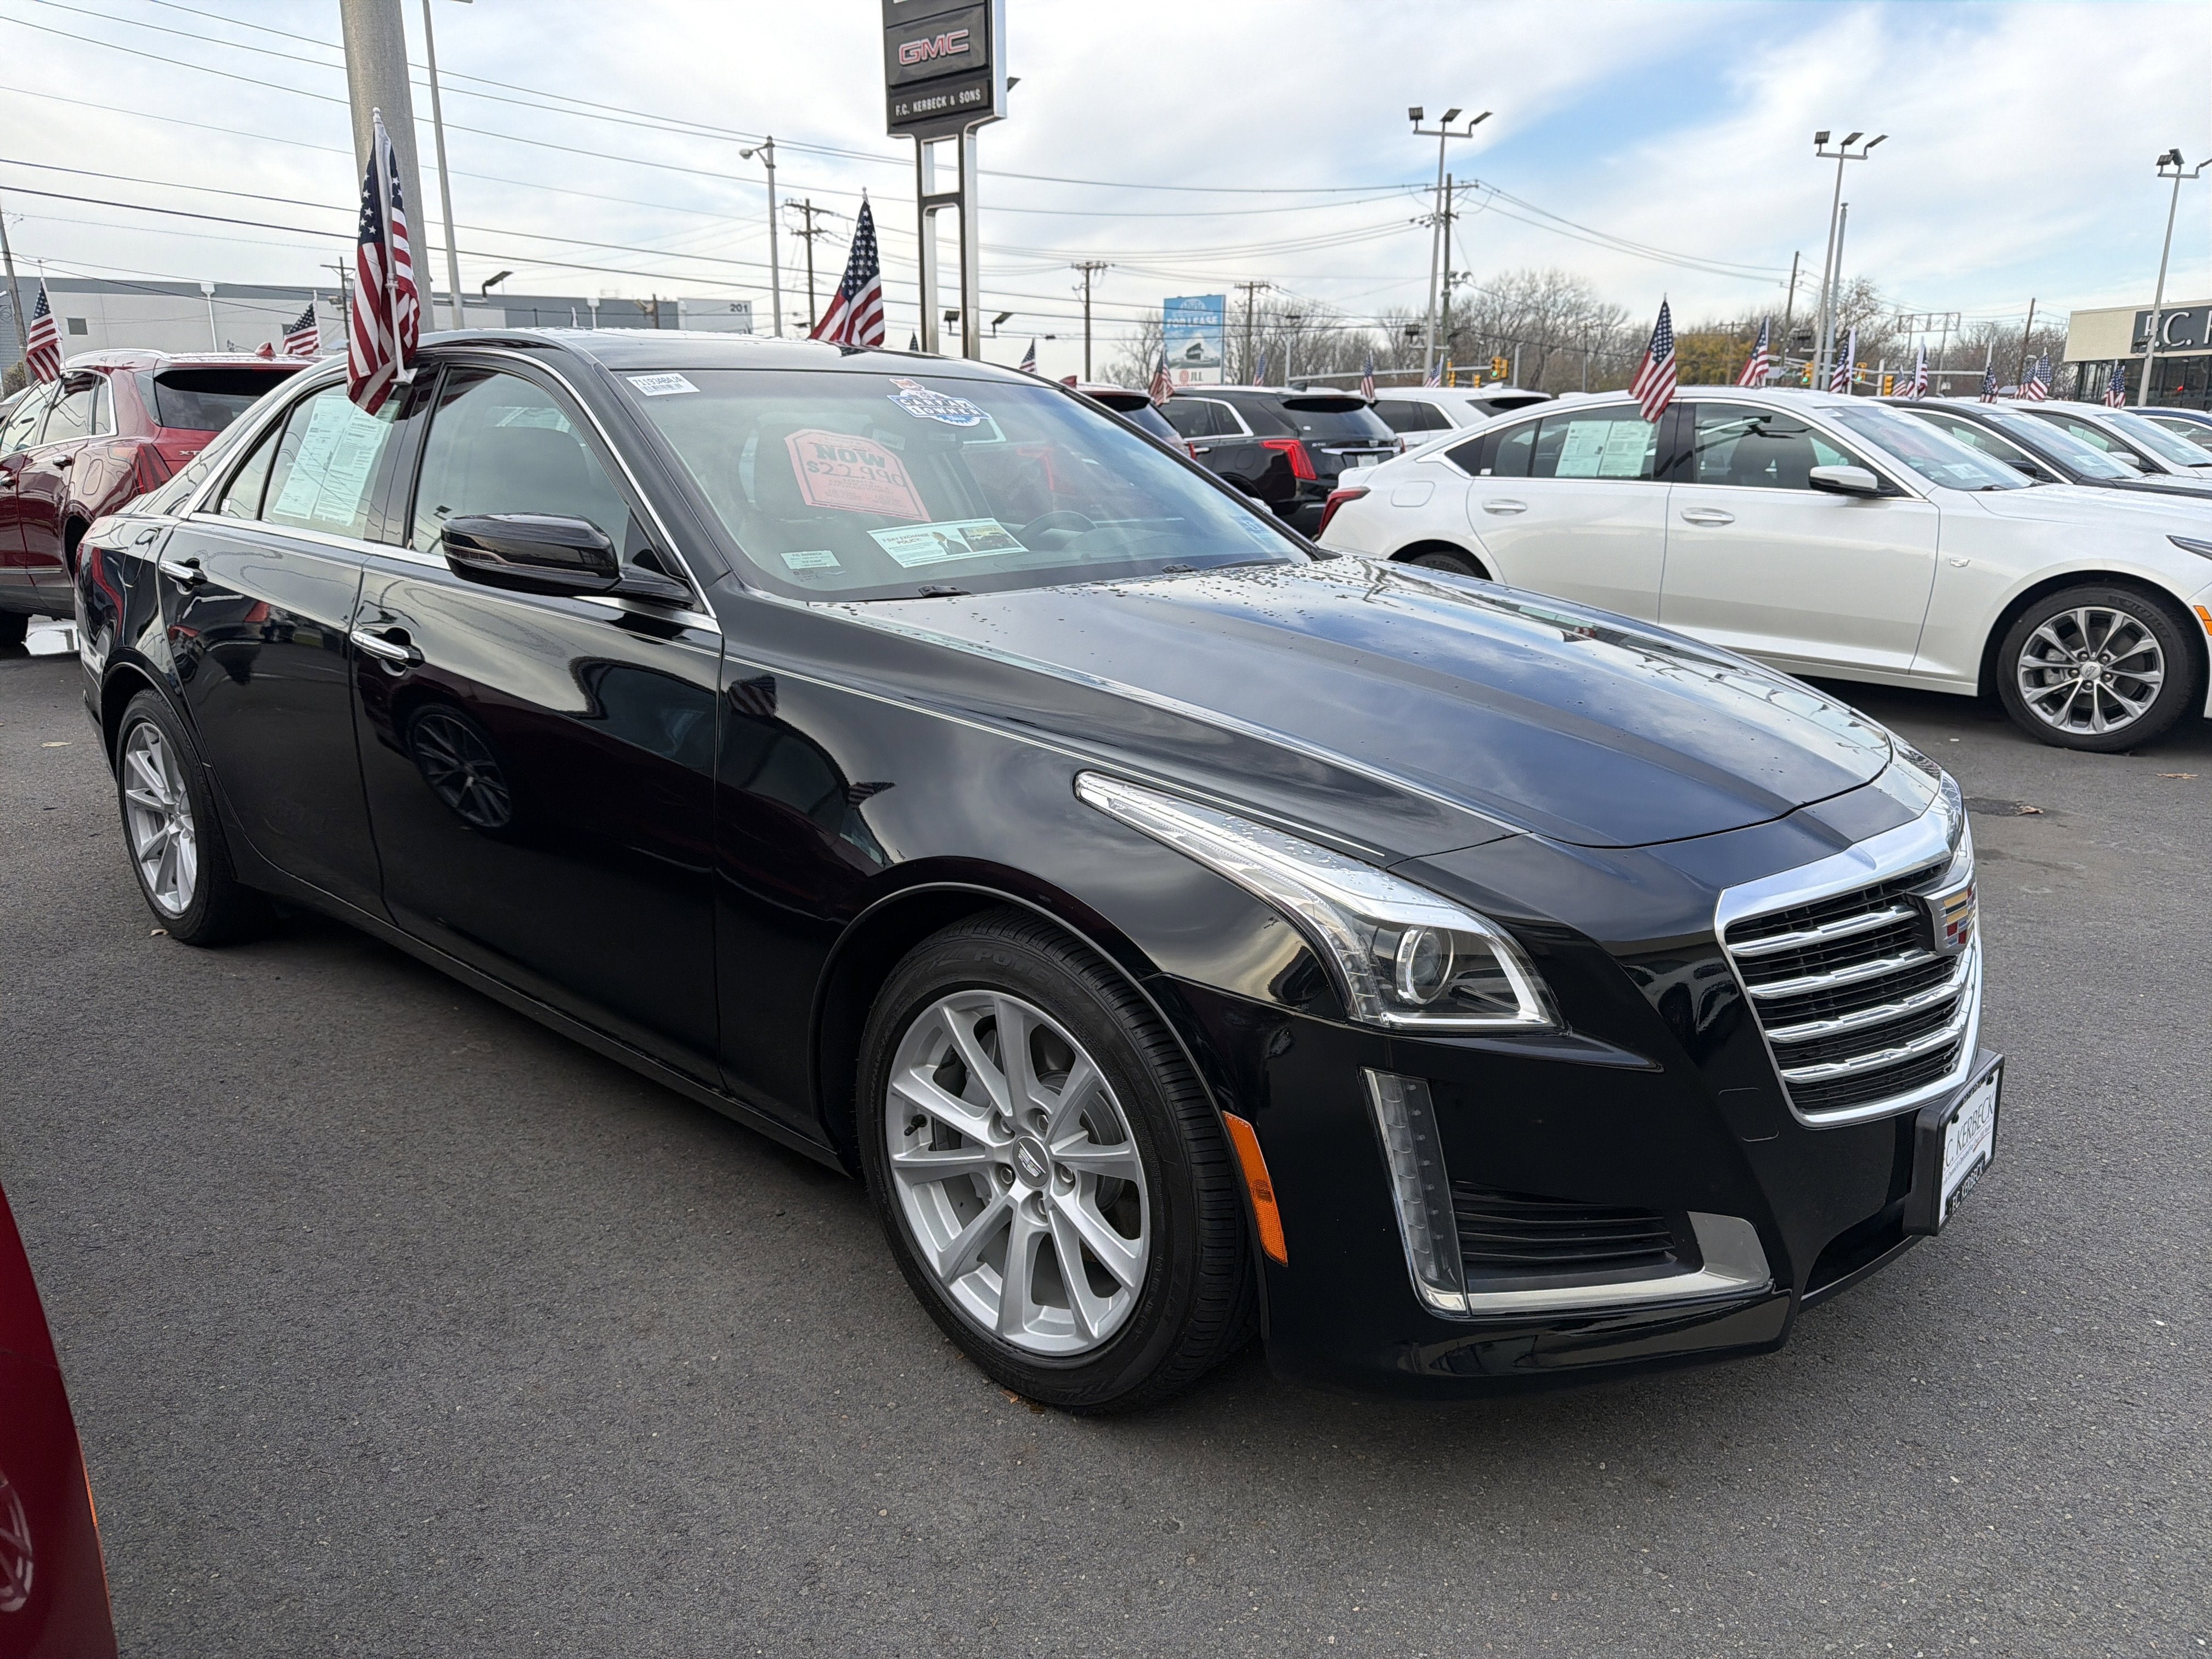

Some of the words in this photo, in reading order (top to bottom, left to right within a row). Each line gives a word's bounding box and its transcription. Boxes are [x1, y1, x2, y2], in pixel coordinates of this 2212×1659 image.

[899, 29, 969, 65] GMC
[912, 95, 947, 113] KERBECK
[950, 95, 956, 105] &
[959, 88, 981, 104] SONS
[730, 303, 748, 313] 201
[923, 407, 982, 416] OWNER
[815, 443, 885, 469] NOW
[1943, 1138, 1954, 1172] .C.
[1956, 1091, 1995, 1156] KERBECK
[1961, 1159, 1984, 1202] KERBECK
